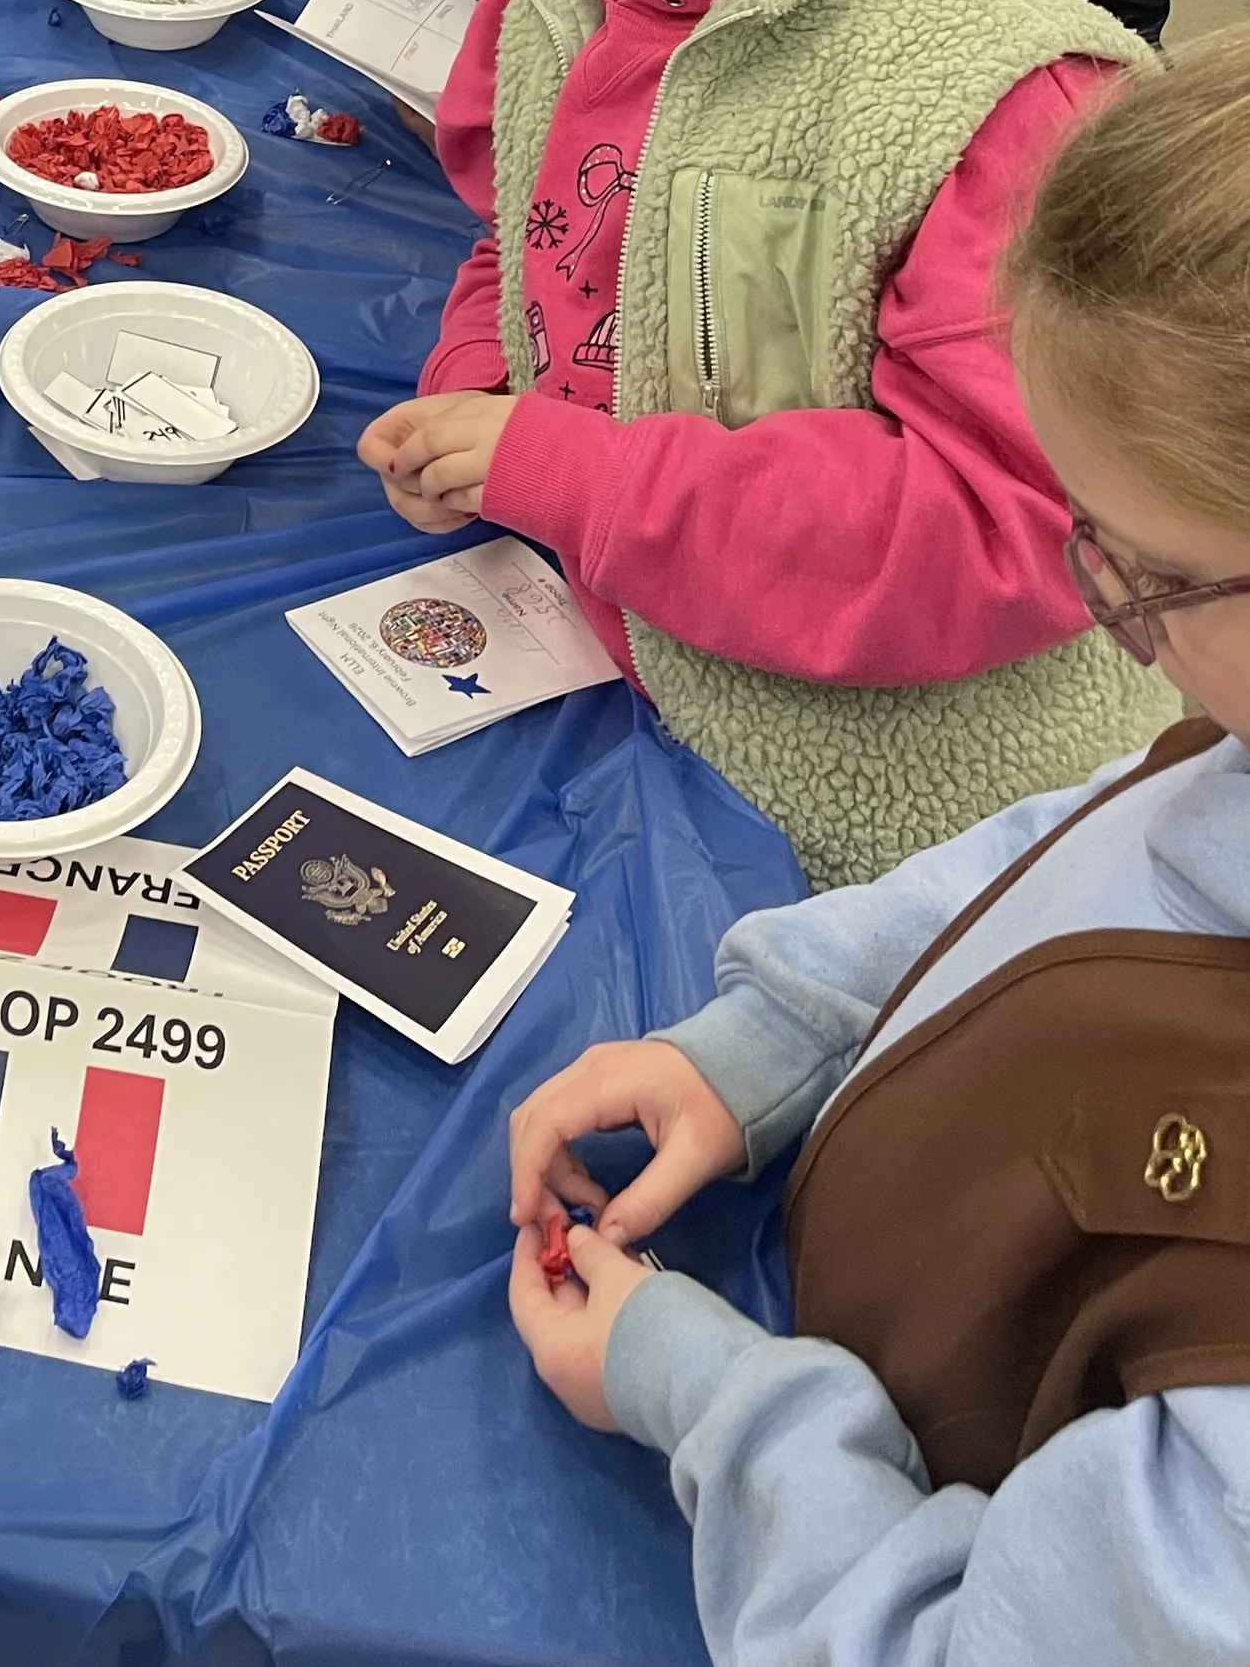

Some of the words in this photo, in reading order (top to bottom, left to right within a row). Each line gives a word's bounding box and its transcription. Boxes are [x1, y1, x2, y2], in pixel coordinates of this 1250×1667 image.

[318, 611, 341, 631] Night
[502, 593, 528, 617] Name
[336, 629, 387, 676] International
[340, 653, 365, 675] ELLM
[379, 649, 412, 683] February
[384, 675, 417, 707] Brownie
[231, 809, 311, 882] PASSPORT
[386, 920, 417, 951] United
[410, 899, 437, 926] States
[414, 910, 448, 945] America
[92, 1007, 227, 1070] 2499
